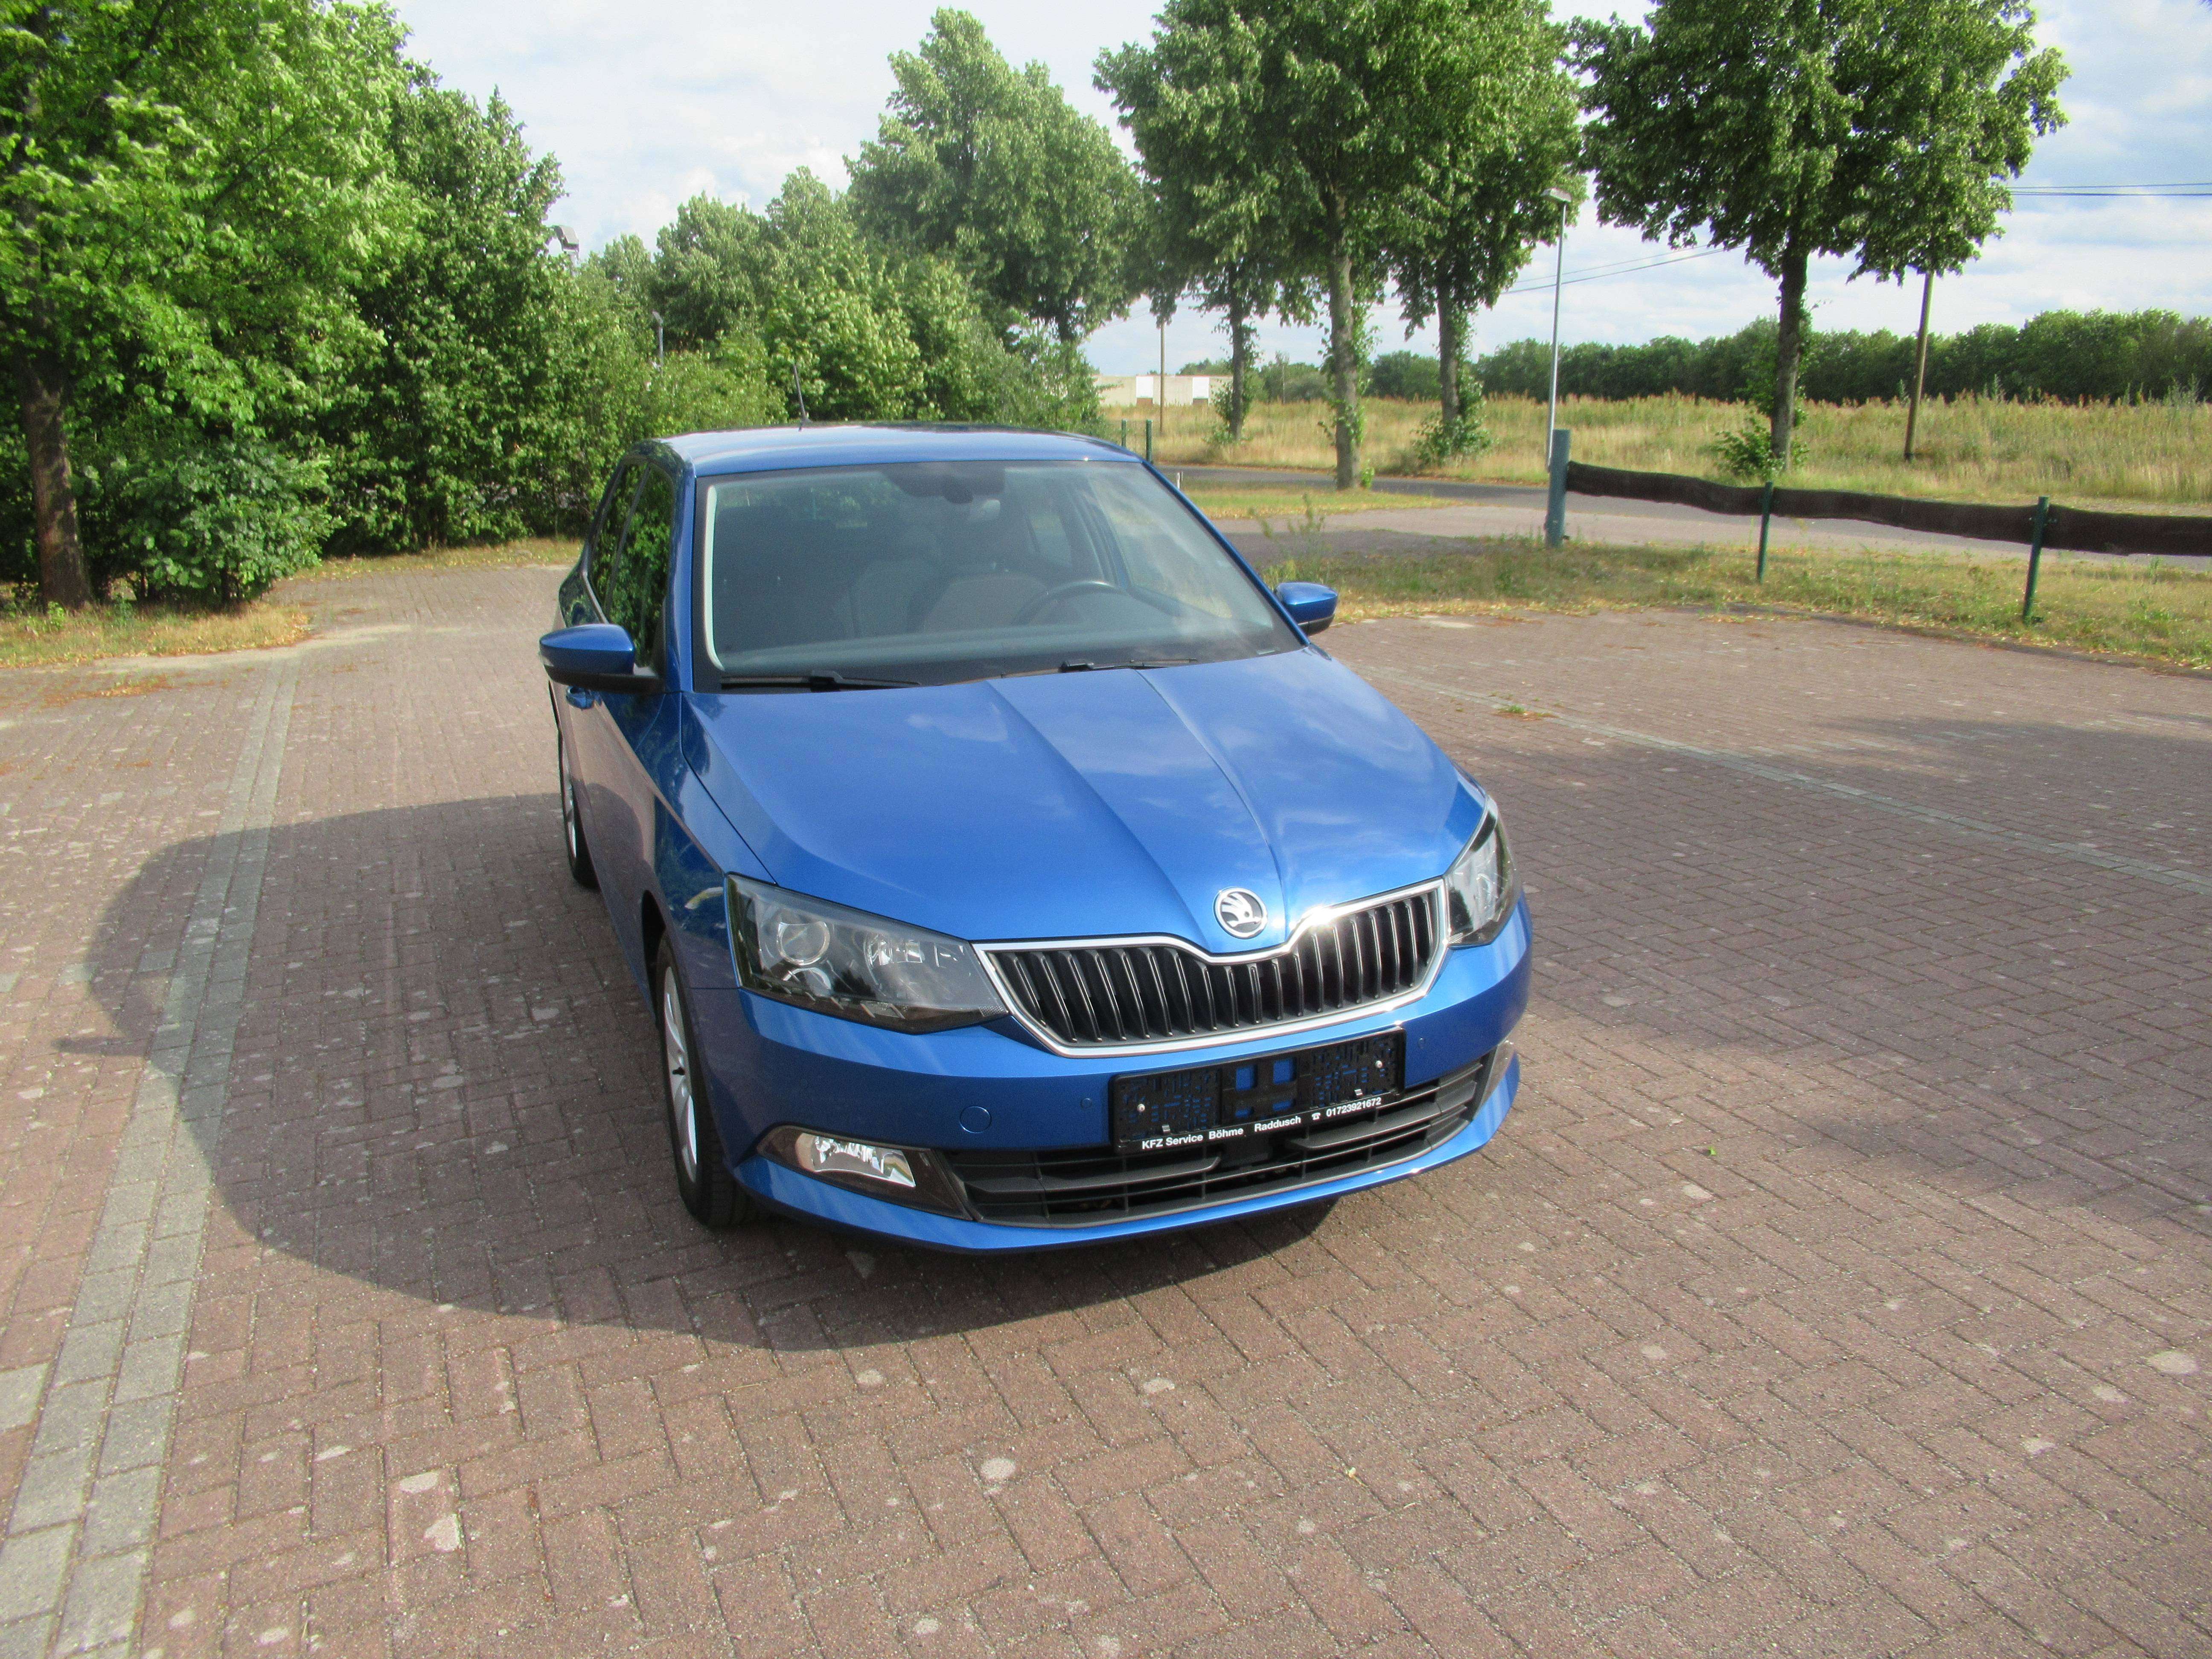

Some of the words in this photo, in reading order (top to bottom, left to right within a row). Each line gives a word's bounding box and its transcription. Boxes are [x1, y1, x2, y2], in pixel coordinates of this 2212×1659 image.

[1142, 1138, 1163, 1150] KFZ
[1165, 1134, 1204, 1146] Service
[1209, 1128, 1244, 1139] Böhme
[1254, 1115, 1301, 1132] Raddusch
[1326, 1097, 1381, 1117] 01723921672
